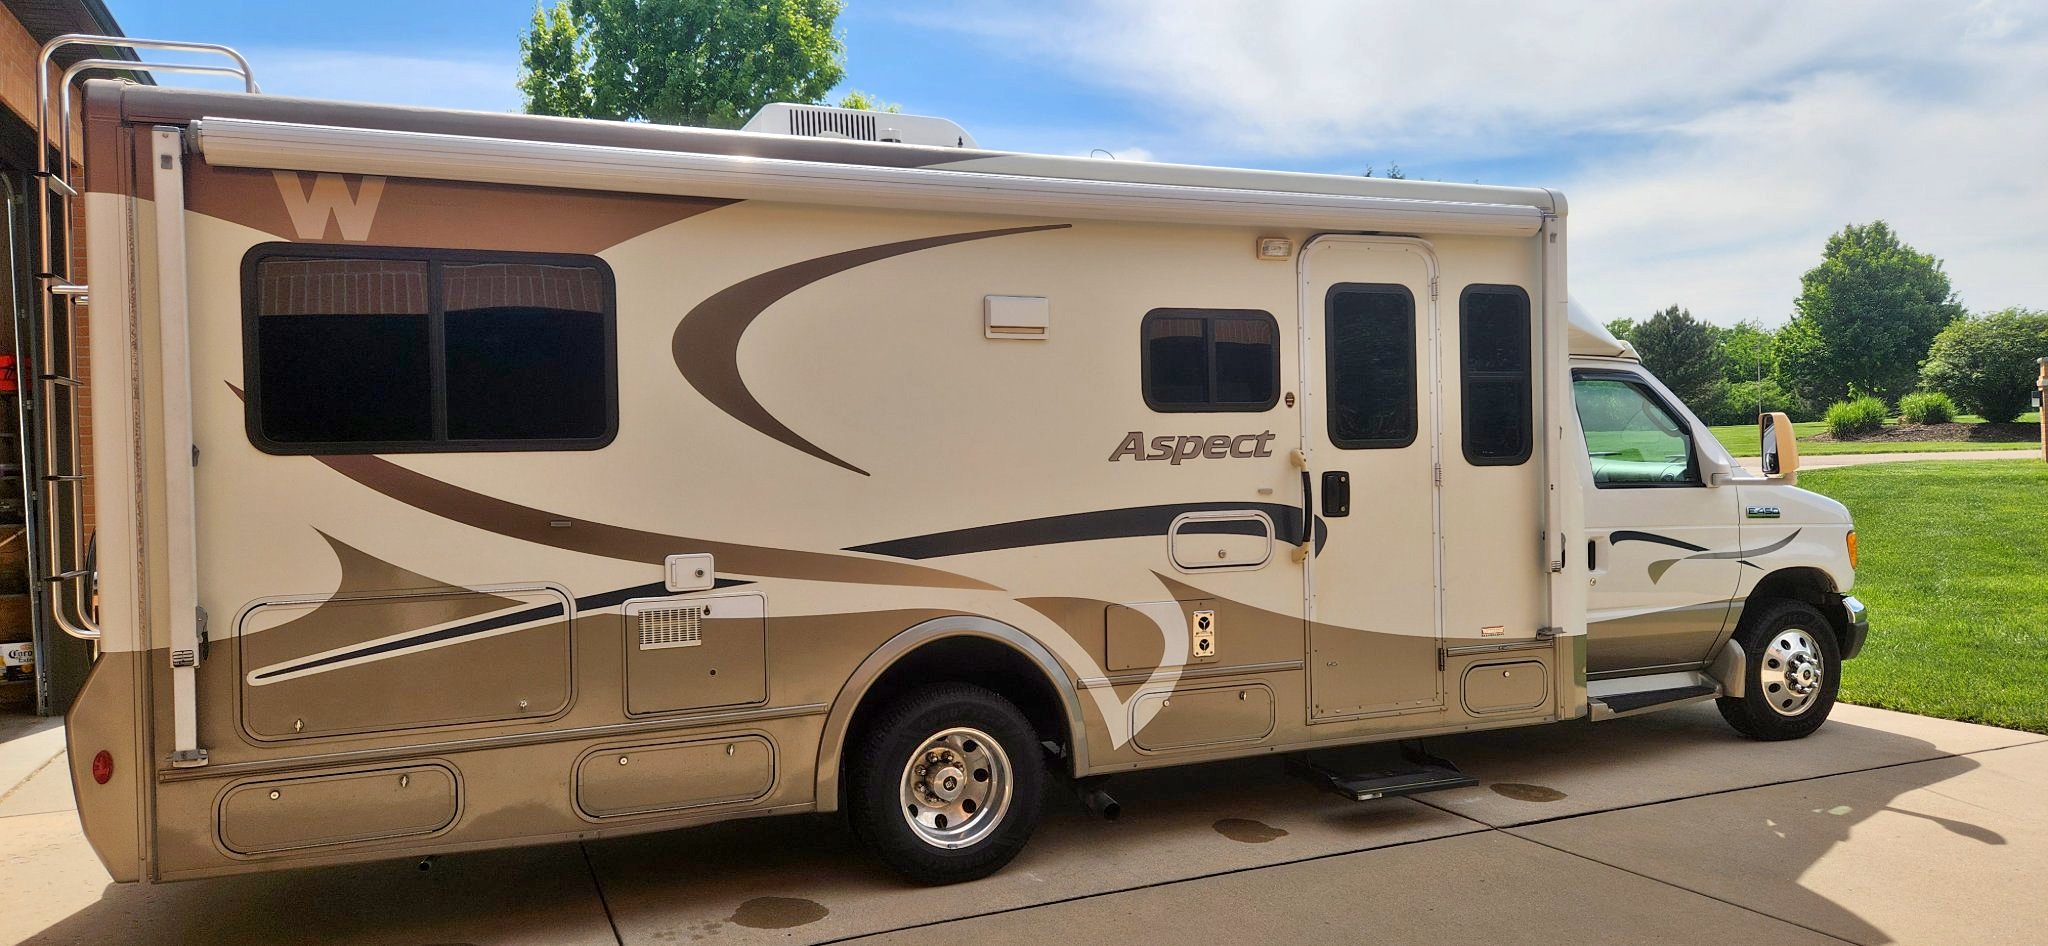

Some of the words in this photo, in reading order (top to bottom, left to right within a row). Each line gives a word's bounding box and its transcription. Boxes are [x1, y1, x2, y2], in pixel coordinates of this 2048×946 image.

[272, 170, 387, 242] W
[1108, 430, 1276, 466] Aspect
[1748, 507, 1780, 515] E450
